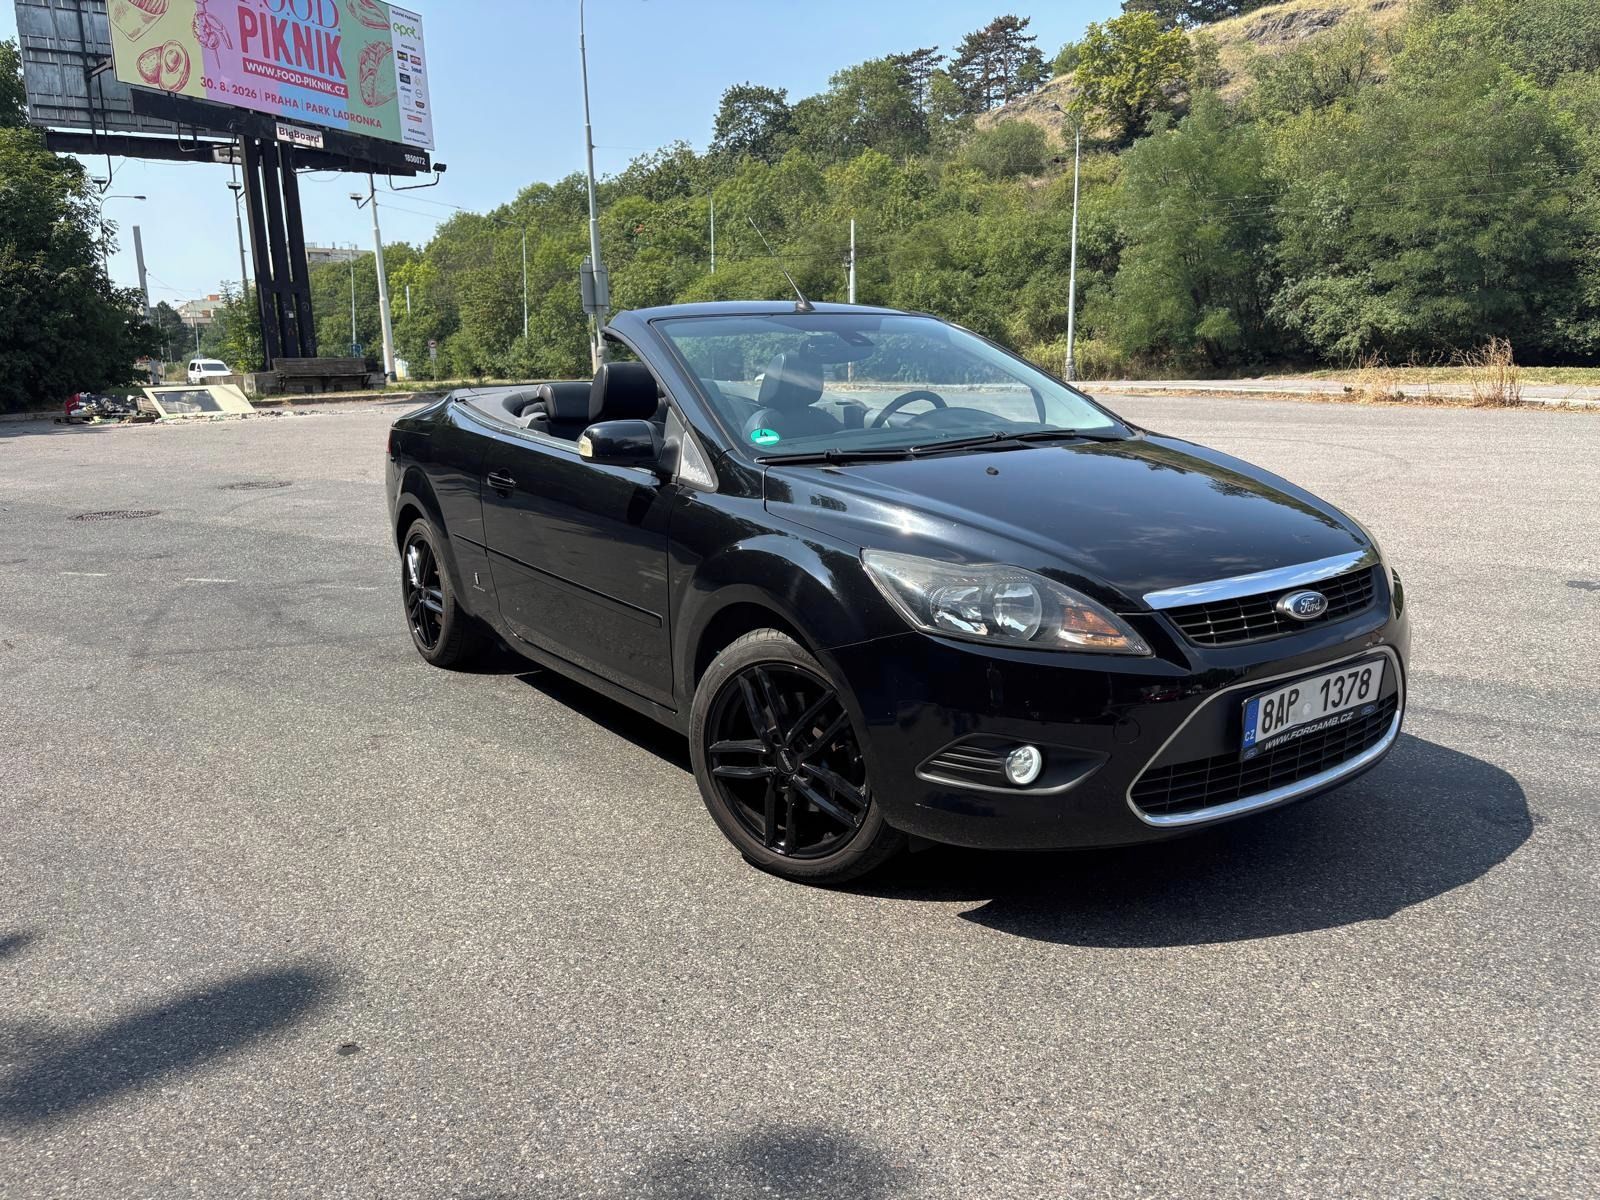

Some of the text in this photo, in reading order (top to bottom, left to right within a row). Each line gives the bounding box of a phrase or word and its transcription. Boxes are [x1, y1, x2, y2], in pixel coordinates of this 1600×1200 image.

[238, 5, 347, 80] PIKNIK
[245, 61, 346, 96] WWW.FOOD-PIKNIK.CZ
[200, 76, 382, 128] 30. 8. 2026 PRAHA PARK LADRONKA
[1300, 596, 1321, 613] Ford
[1261, 667, 1372, 734] 8AP 1378
[1244, 729, 1256, 742] CZ
